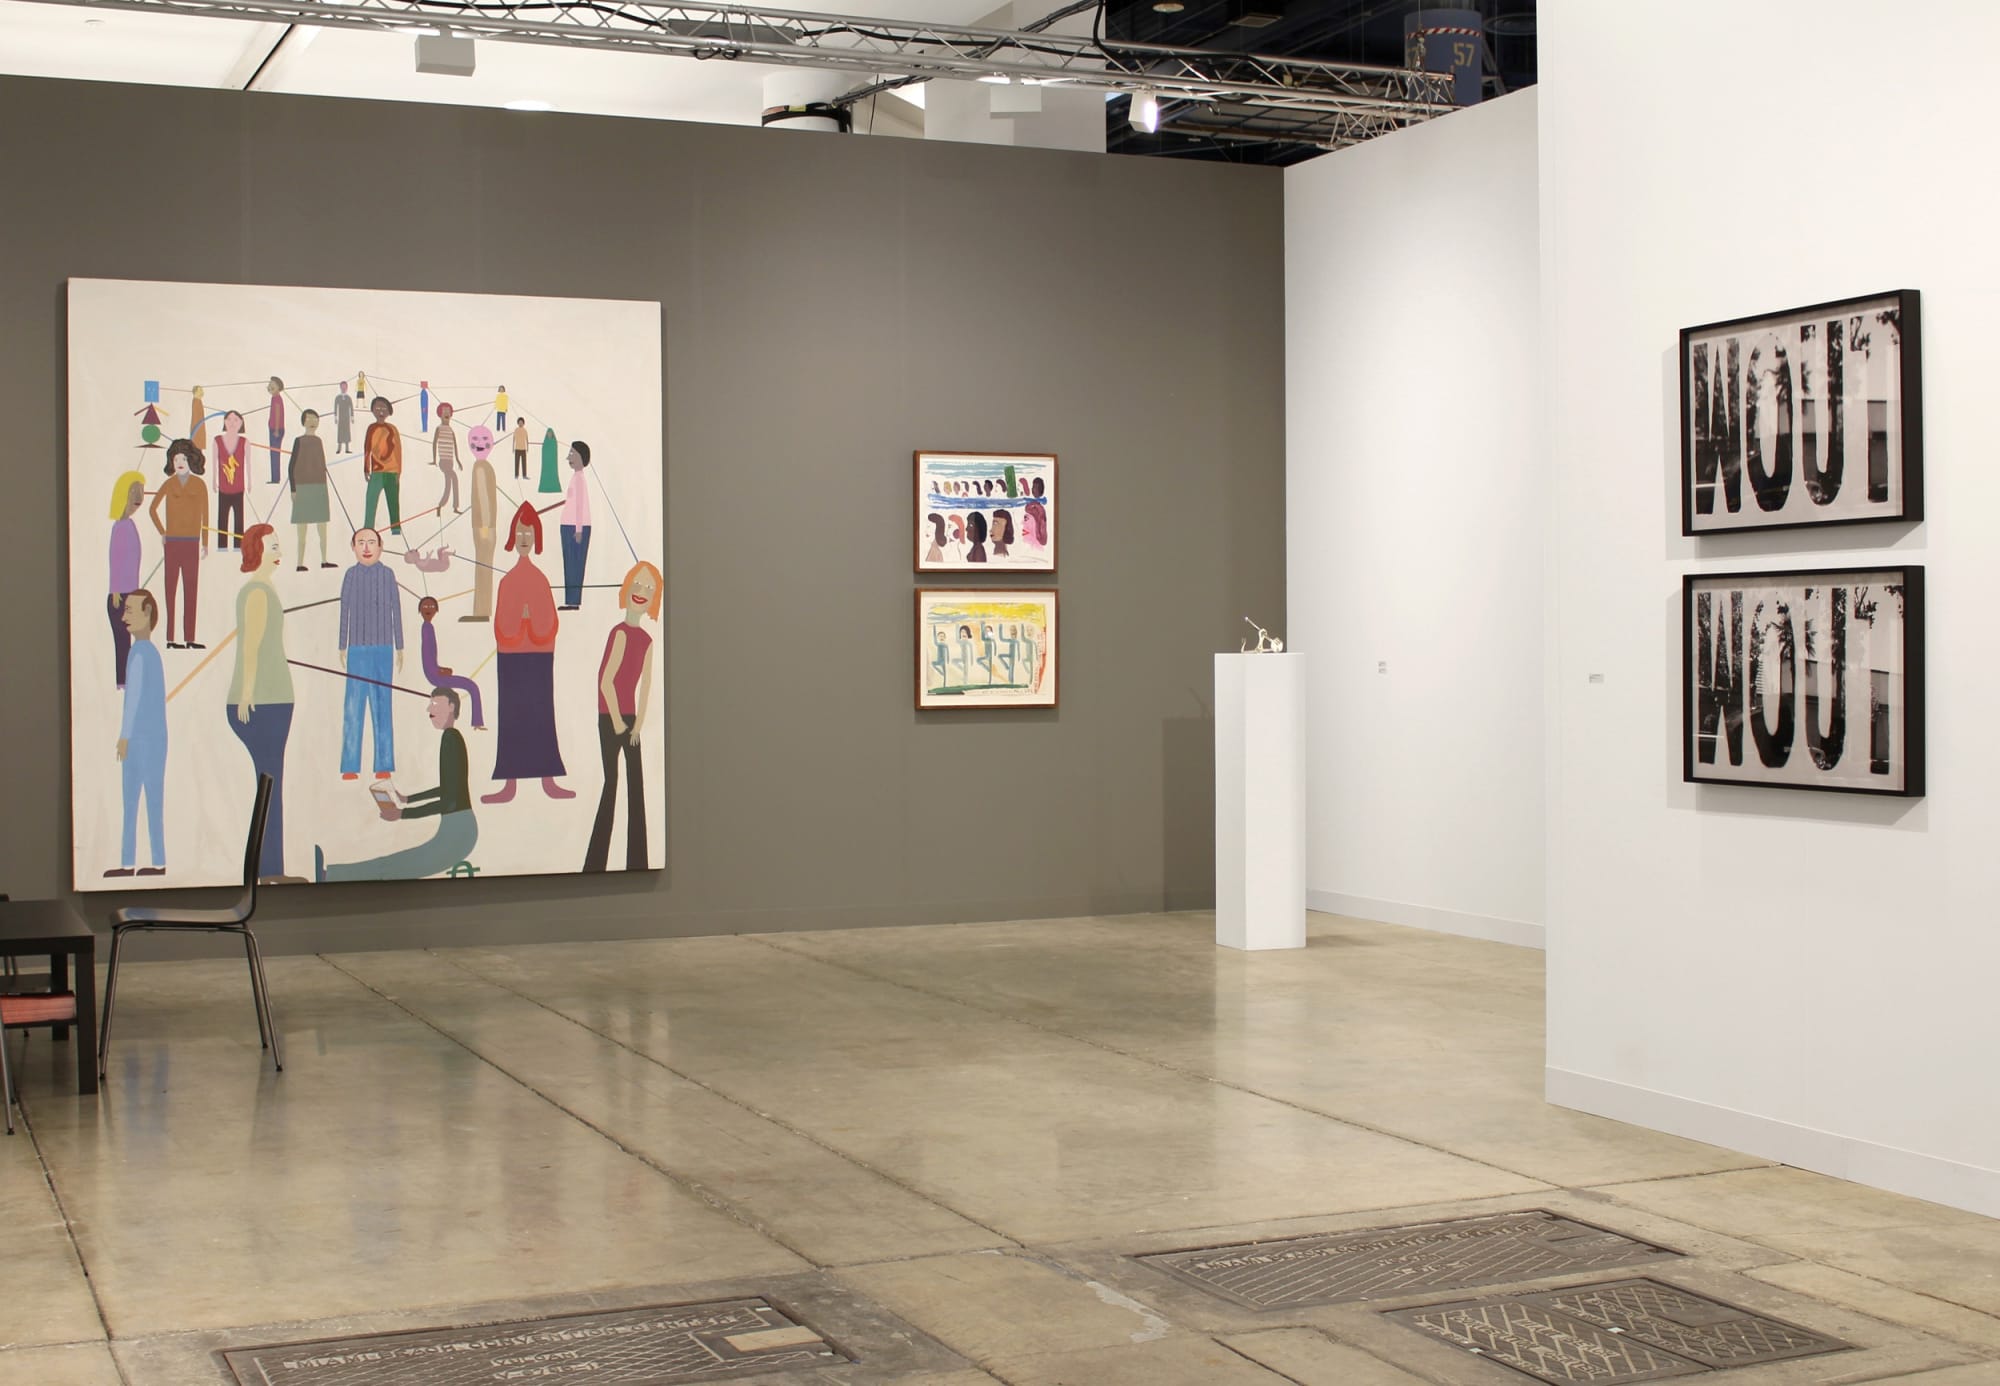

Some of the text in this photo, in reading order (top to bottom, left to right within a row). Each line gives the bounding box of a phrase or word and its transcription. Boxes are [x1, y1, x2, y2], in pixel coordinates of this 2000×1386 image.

[1453, 43, 1474, 67] 57
[299, 1353, 368, 1369] MIAMI
[380, 1344, 457, 1360] BEACH
[467, 1326, 614, 1348] CONVENTION
